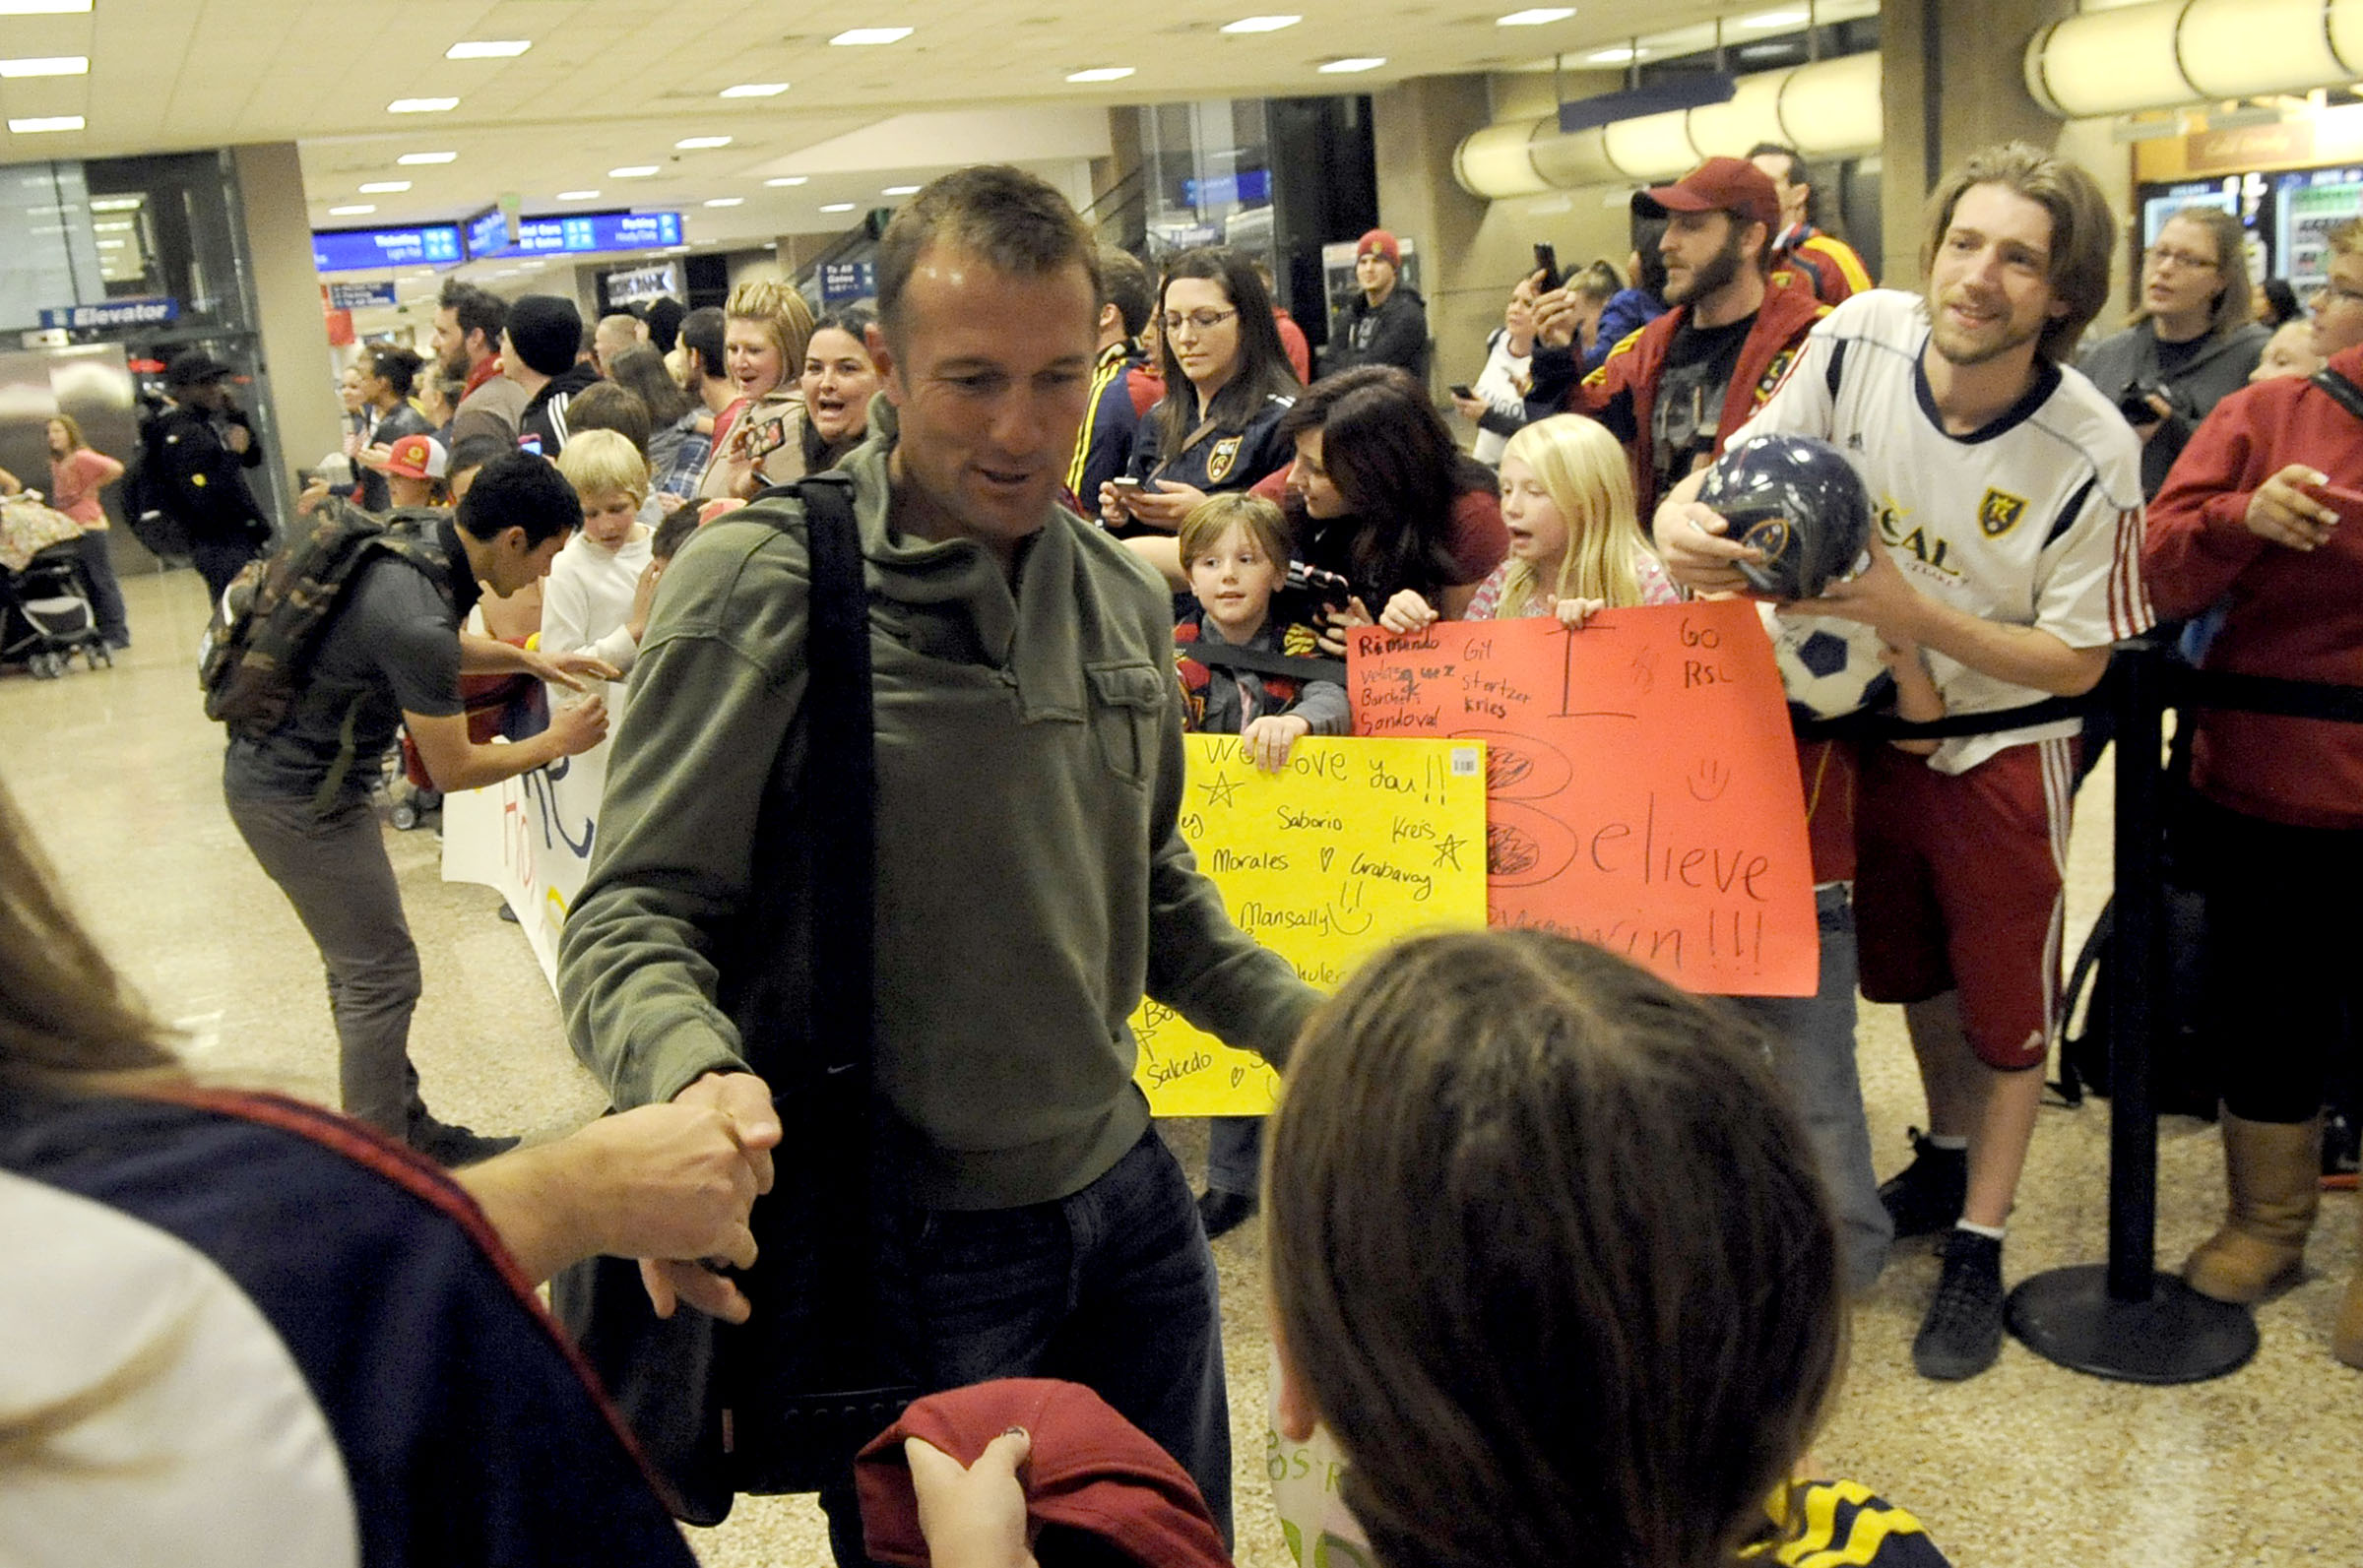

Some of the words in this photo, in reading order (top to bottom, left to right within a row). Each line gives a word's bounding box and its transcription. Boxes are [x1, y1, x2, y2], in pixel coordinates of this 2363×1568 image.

[74, 303, 168, 328] Elevator
[1872, 500, 1959, 577] EAL
[1276, 805, 1343, 831] Saborio
[1391, 816, 1437, 844] Kreis
[1213, 848, 1290, 873] Morales
[1240, 902, 1329, 937] Mansally
[1146, 1051, 1213, 1091] Salcedo
